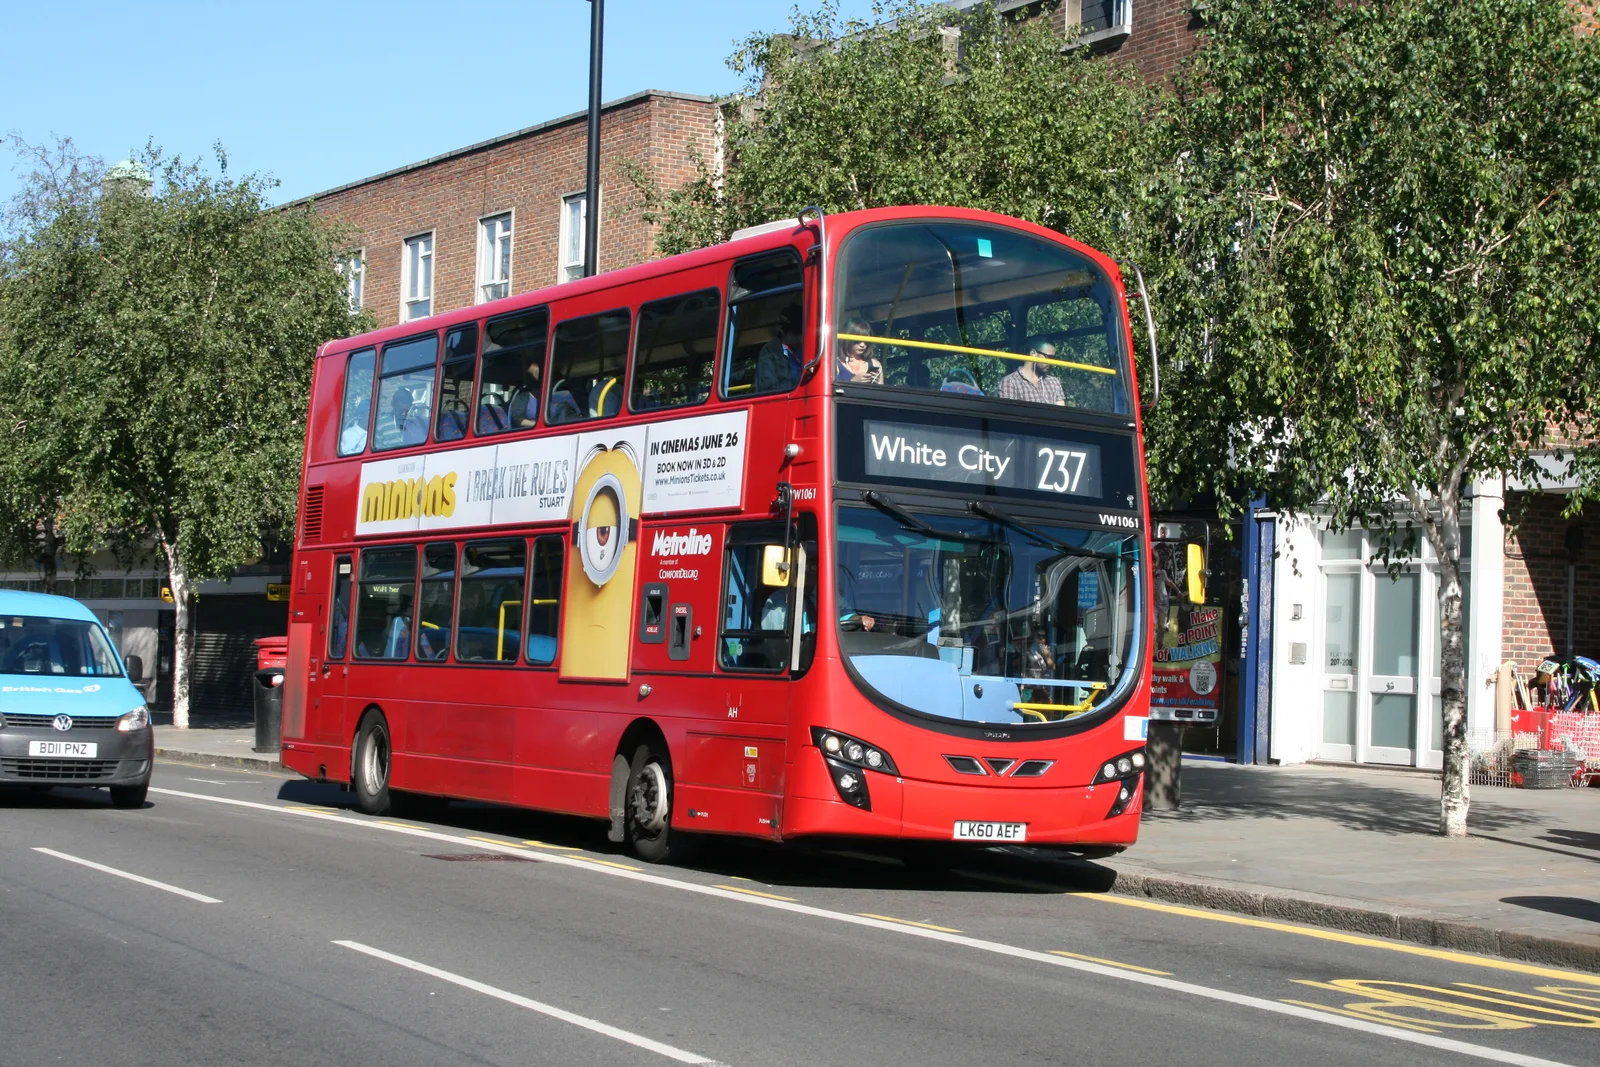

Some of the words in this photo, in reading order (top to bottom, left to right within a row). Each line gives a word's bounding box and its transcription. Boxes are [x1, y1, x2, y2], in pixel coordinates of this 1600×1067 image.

[650, 441, 660, 456] IN
[661, 436, 700, 455] CINEMAS
[700, 433, 724, 450] JUNE
[725, 431, 739, 447] 26
[656, 461, 676, 474] BOOK
[676, 459, 695, 472] NOW
[695, 459, 702, 470] IN
[702, 458, 712, 469] 3D
[712, 459, 716, 468] &
[716, 456, 727, 468] 2D
[871, 434, 947, 467] White
[958, 444, 1011, 480] City
[1037, 447, 1087, 492] 237
[466, 471, 472, 503] I
[473, 466, 507, 502] BREAK
[508, 463, 530, 498] THE
[530, 459, 569, 496] RULES
[655, 471, 726, 486] www.MinionsTickets.co.uk
[361, 471, 458, 523] MINIONS
[539, 495, 565, 509] STUART
[790, 487, 817, 500] W1061
[1098, 513, 1139, 529] VW1061
[651, 528, 712, 557] Metroline
[1190, 608, 1219, 625] Make
[1178, 632, 1186, 644] a
[1187, 622, 1217, 642] POINT
[1157, 648, 1169, 660] of
[1170, 639, 1218, 661] WALKING
[1162, 674, 1178, 683] walk
[1151, 685, 1167, 694] oints
[727, 707, 738, 718] AH
[39, 742, 62, 754] BD11
[64, 743, 88, 755] PNZ
[959, 822, 994, 838] LK60
[996, 824, 1021, 839] AEF
